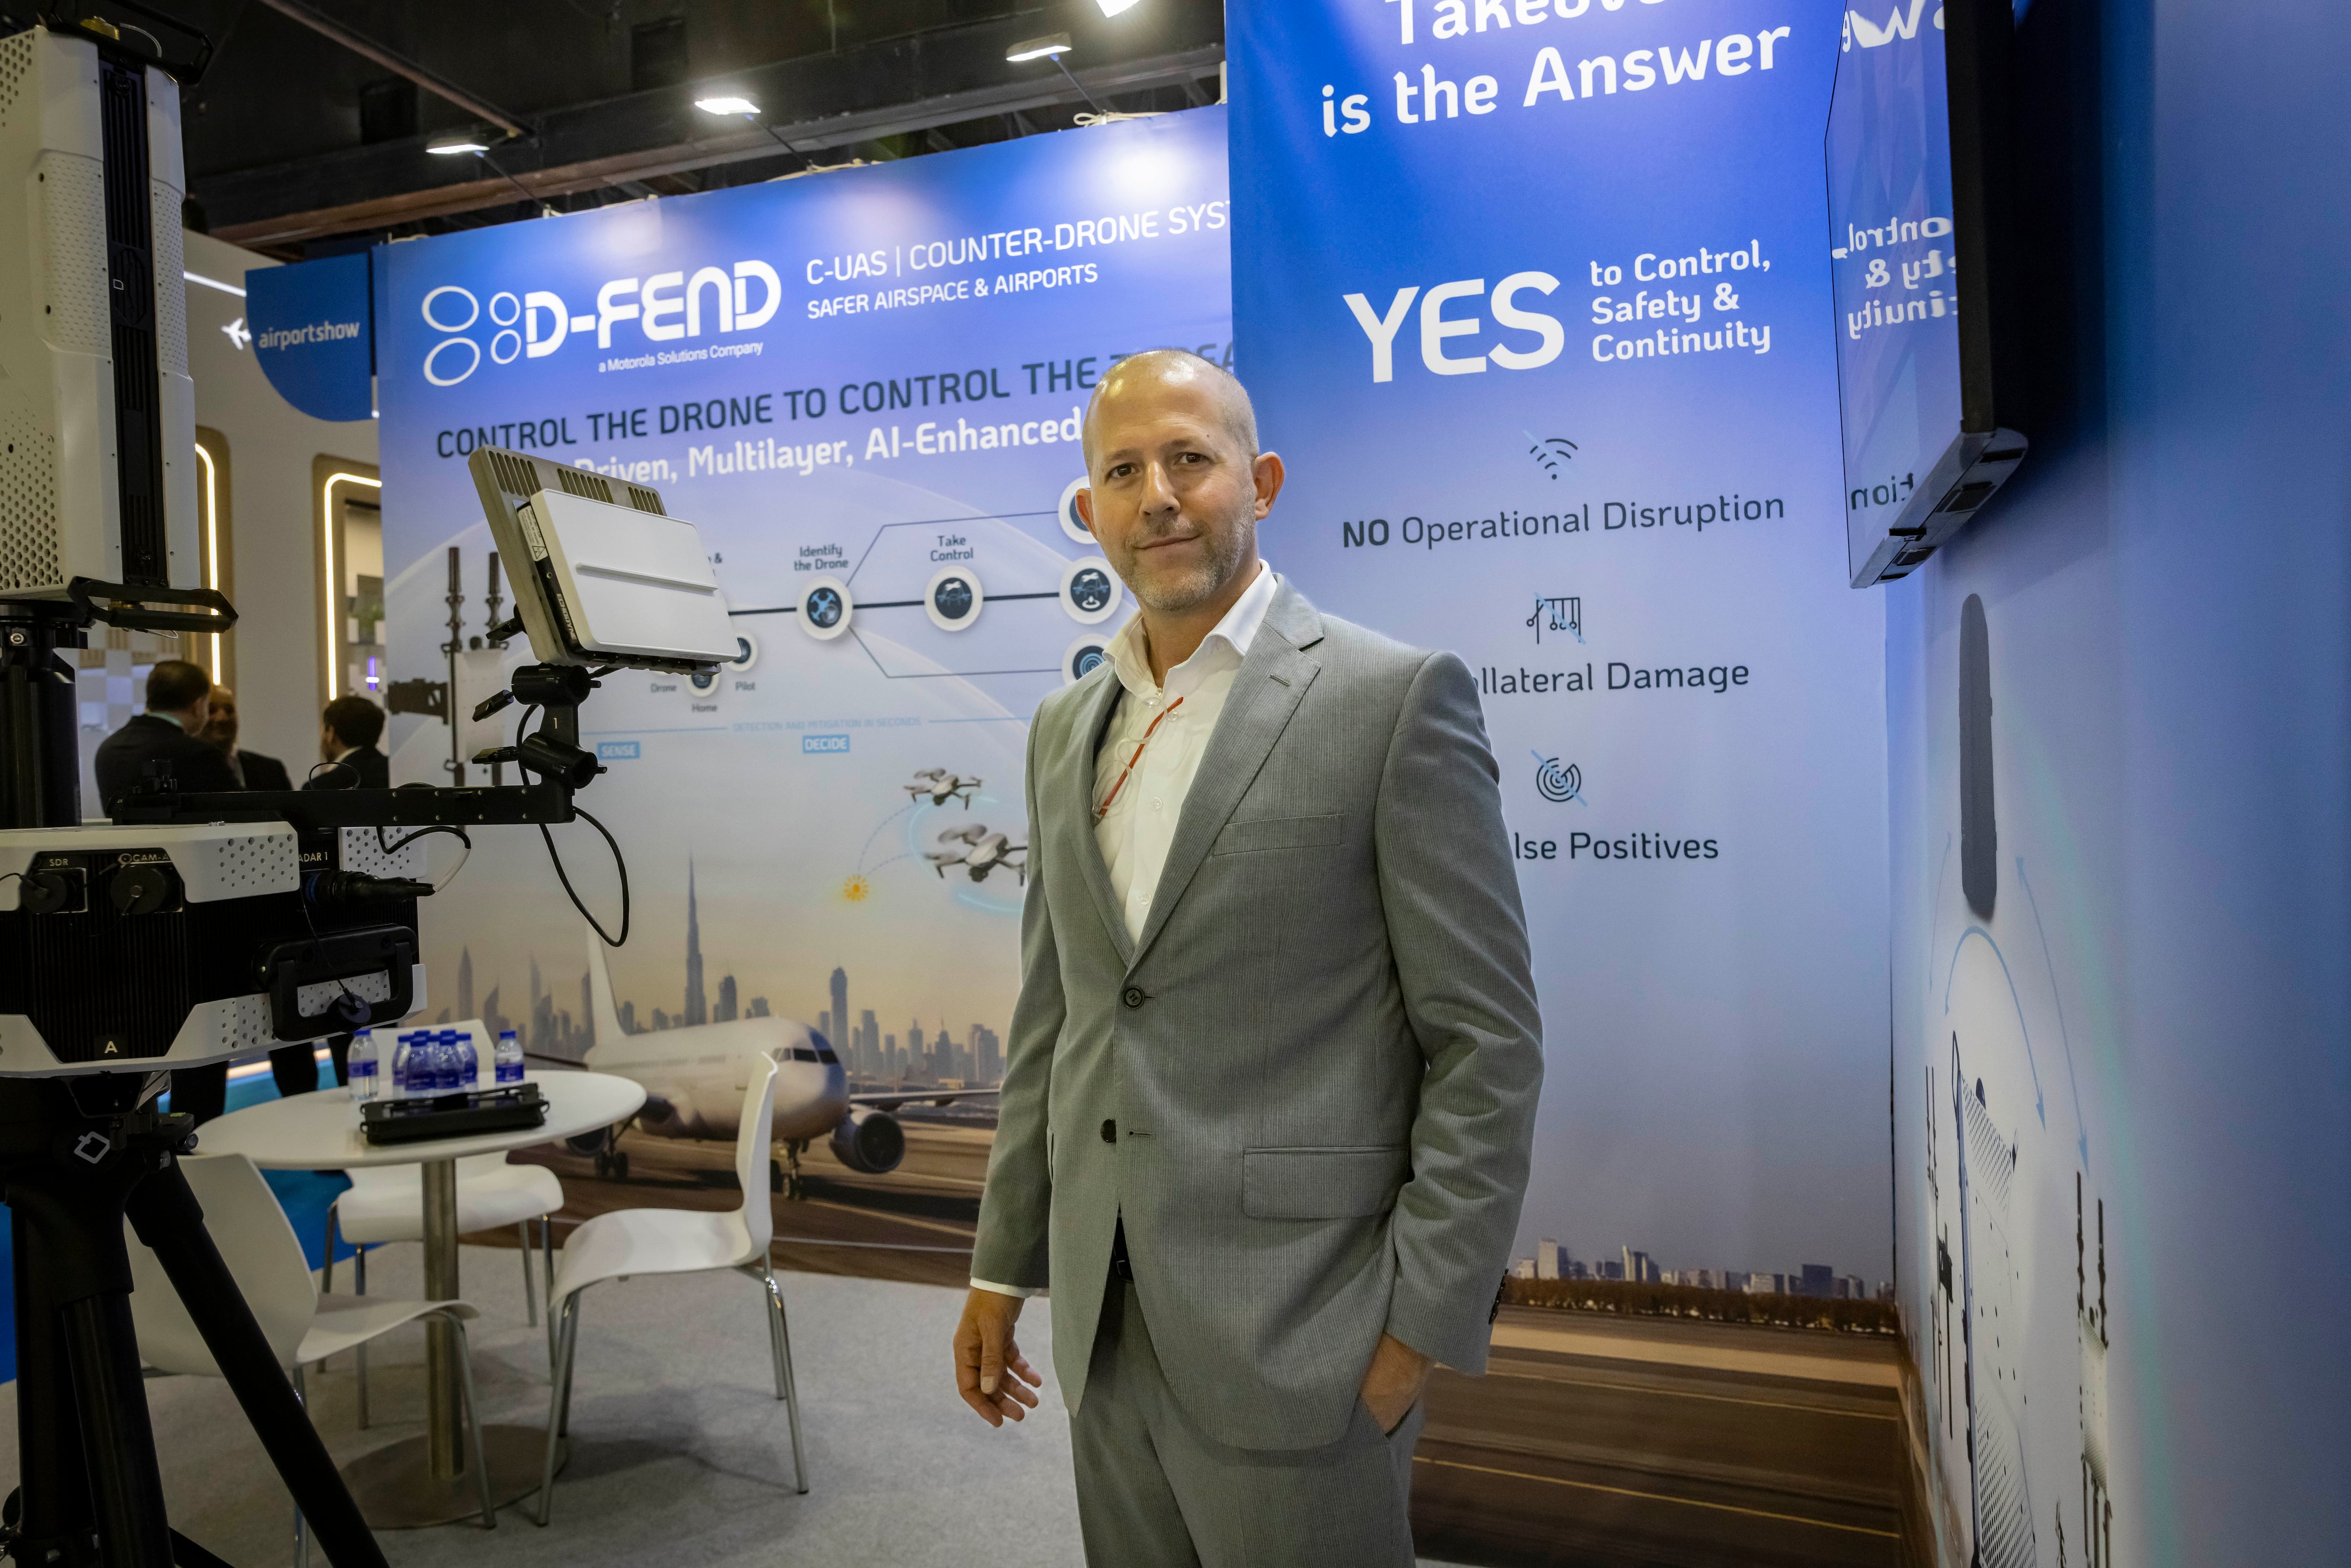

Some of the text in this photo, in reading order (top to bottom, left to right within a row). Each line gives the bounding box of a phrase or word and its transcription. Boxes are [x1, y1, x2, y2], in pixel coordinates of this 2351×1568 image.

[1322, 27, 1790, 137] is the Answer
[807, 250, 887, 284] C-UAS
[909, 210, 1158, 270] COUNTER-DRONE
[1168, 199, 1230, 234] SYS
[1590, 239, 1769, 286] to Control,
[525, 260, 781, 358] D-FEND
[808, 263, 1097, 318] SAFER AIRSPACE & AIRPORTS
[1592, 283, 1739, 324] Safety &
[260, 321, 360, 350] airportshow
[1343, 271, 1564, 383] YES
[1592, 316, 1770, 362] Continuity
[599, 343, 763, 372] a Motorola Solutions Company
[437, 418, 576, 458] CONTROL
[587, 409, 647, 441] THE
[660, 394, 772, 434] DRONE
[784, 388, 826, 420] TO
[840, 368, 1010, 414] CONTROL
[1022, 356, 1097, 395] THE
[689, 438, 853, 476] Multilayer,
[865, 406, 1082, 460] AI-Enhanced
[938, 535, 966, 546] Take
[1344, 495, 1783, 550] NO Operational Disruption
[795, 559, 848, 570] the Drone
[800, 544, 842, 558] Identify
[931, 548, 973, 561] Control
[1473, 662, 1748, 695] llateral Damage
[805, 738, 846, 751] DECIDE
[299, 851, 328, 862] ADAR 1
[1515, 831, 1718, 860] lse Positives
[104, 1041, 118, 1053] A
